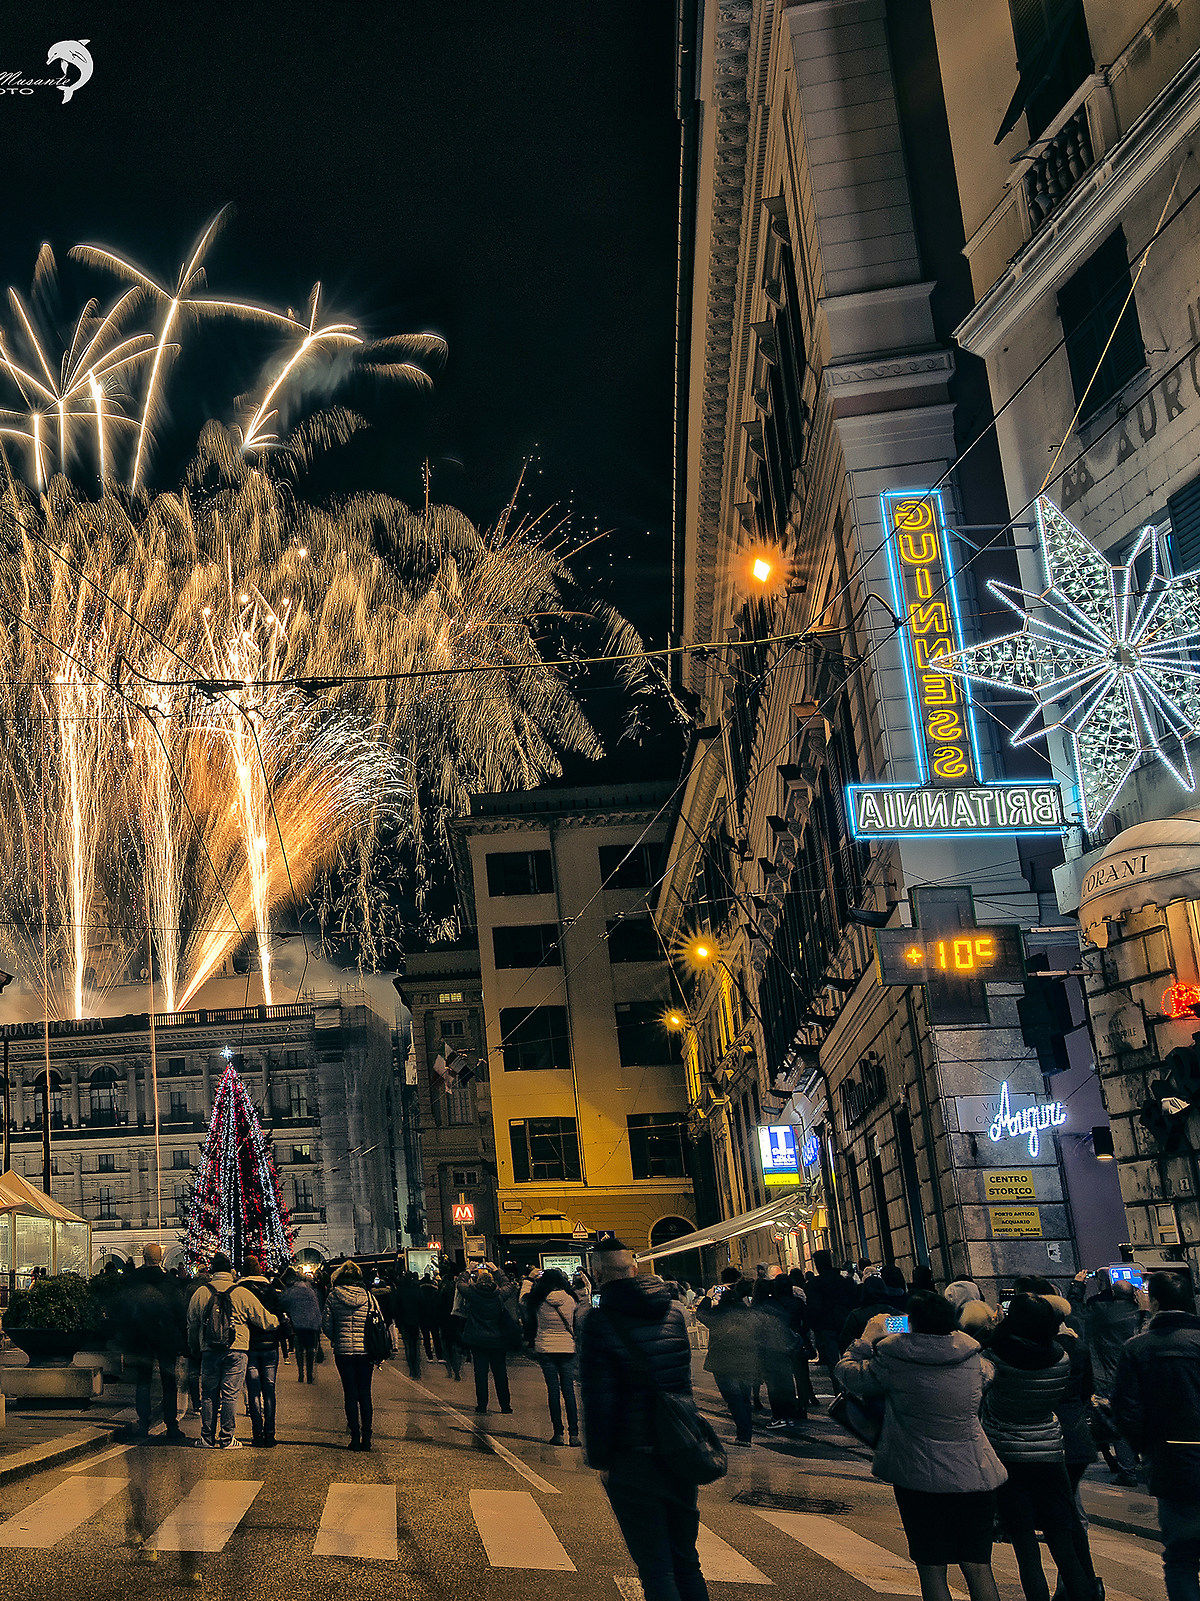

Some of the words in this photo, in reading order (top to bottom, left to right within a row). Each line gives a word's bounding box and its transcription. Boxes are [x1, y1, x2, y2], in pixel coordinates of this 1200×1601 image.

[989, 1175, 1028, 1184] CENTRO
[988, 1187, 1033, 1196] STORICO
[455, 1206, 472, 1218] M
